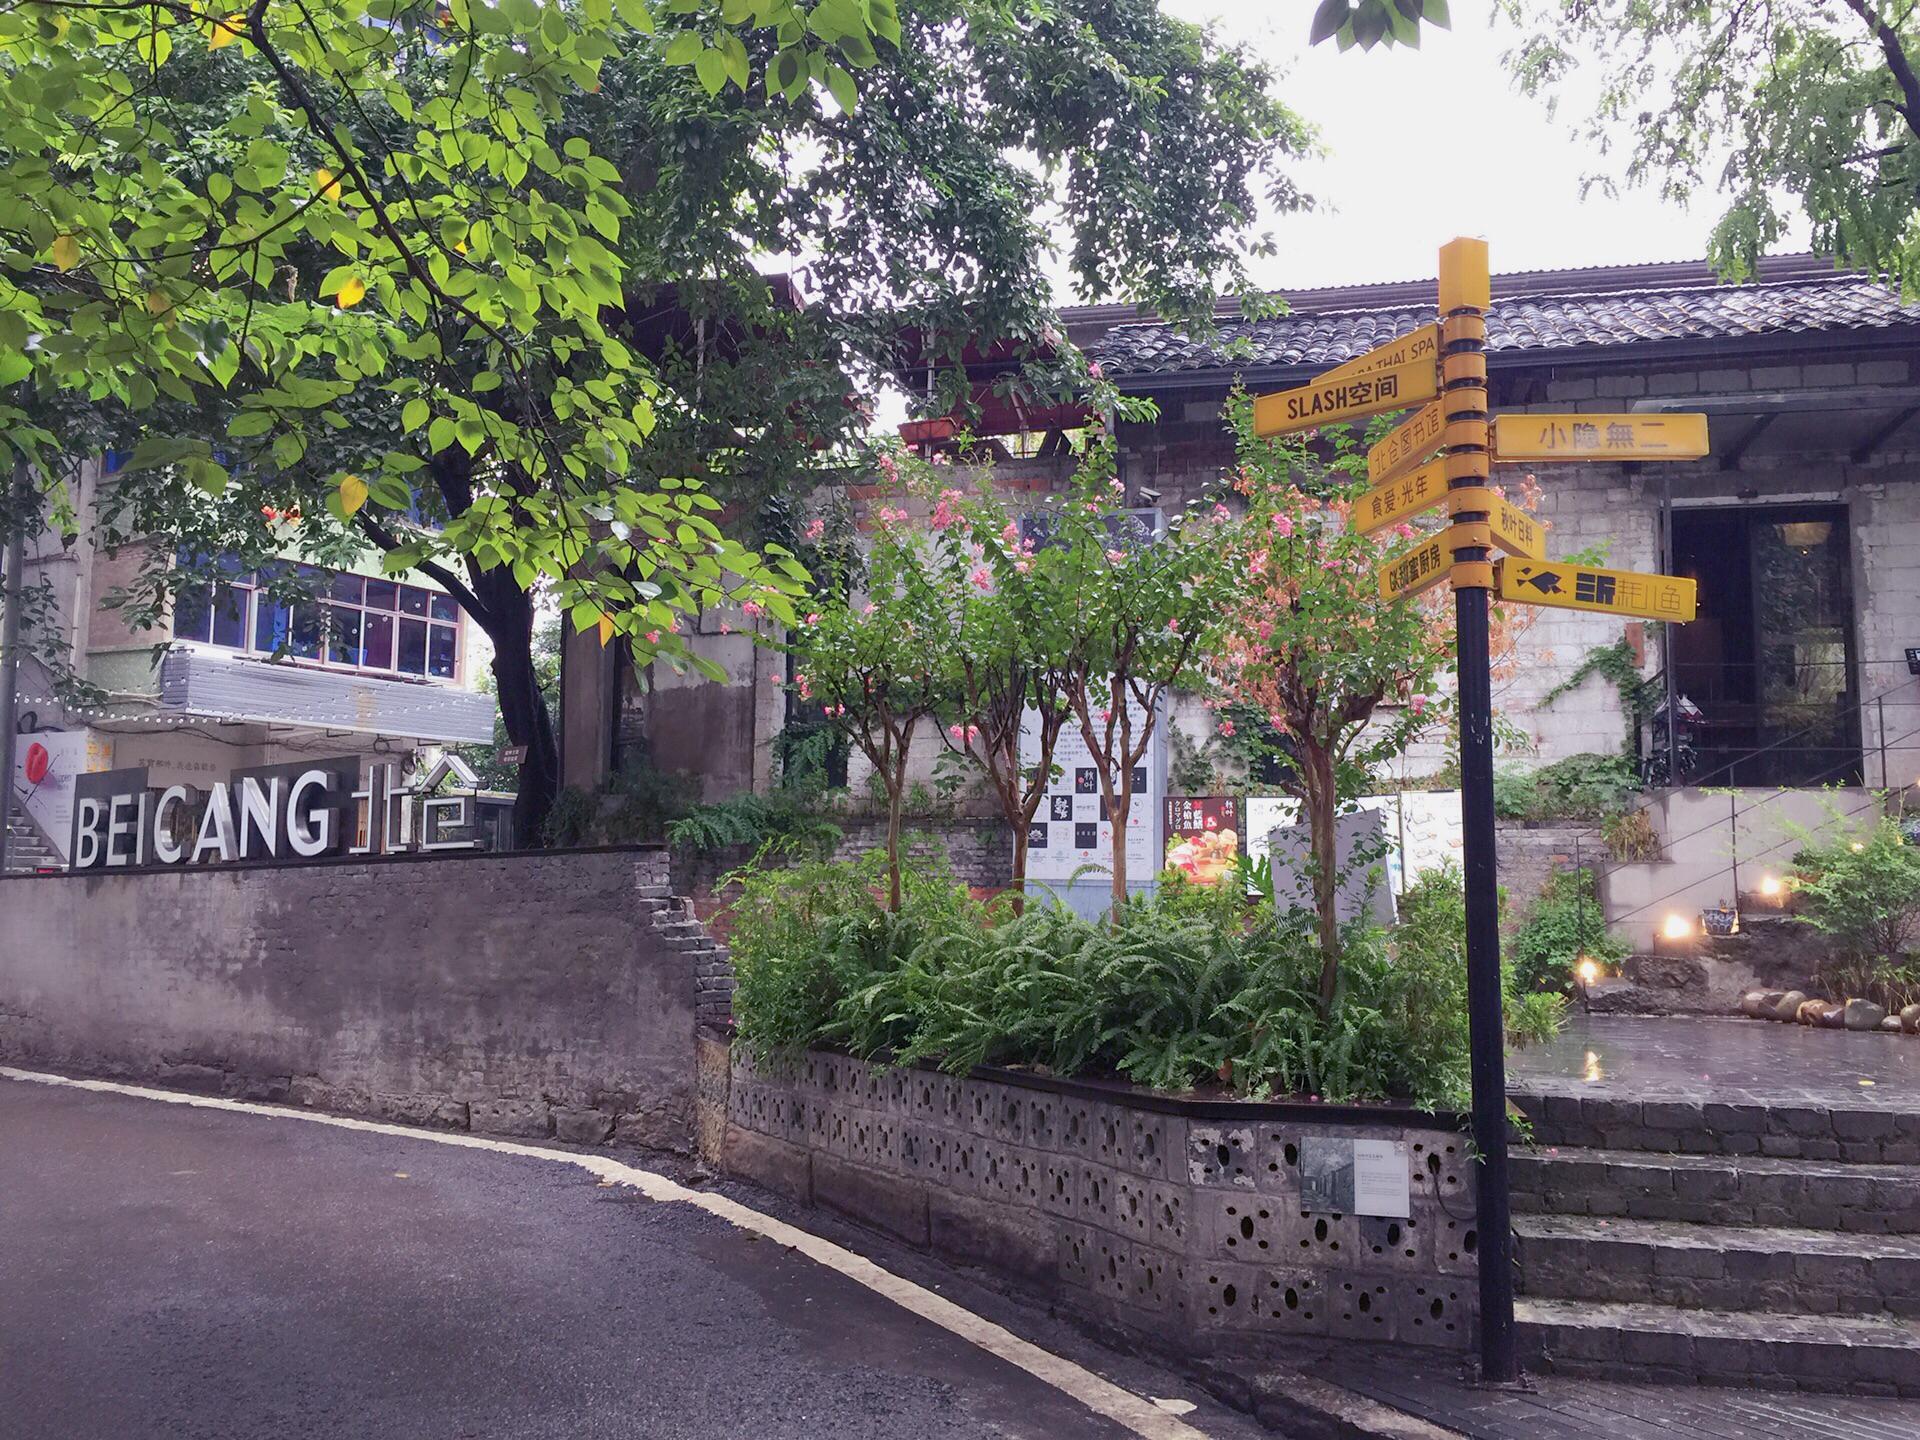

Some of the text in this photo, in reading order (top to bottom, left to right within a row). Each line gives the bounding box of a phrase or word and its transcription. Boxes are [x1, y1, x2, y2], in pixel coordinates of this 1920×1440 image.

[1376, 337, 1435, 369] THAI SPA
[1288, 374, 1398, 420] SLASH空间
[1375, 408, 1439, 476] 北仓图书馆
[1501, 507, 1533, 549] 秋叶日料
[76, 753, 484, 868] BEICANG 北仓
